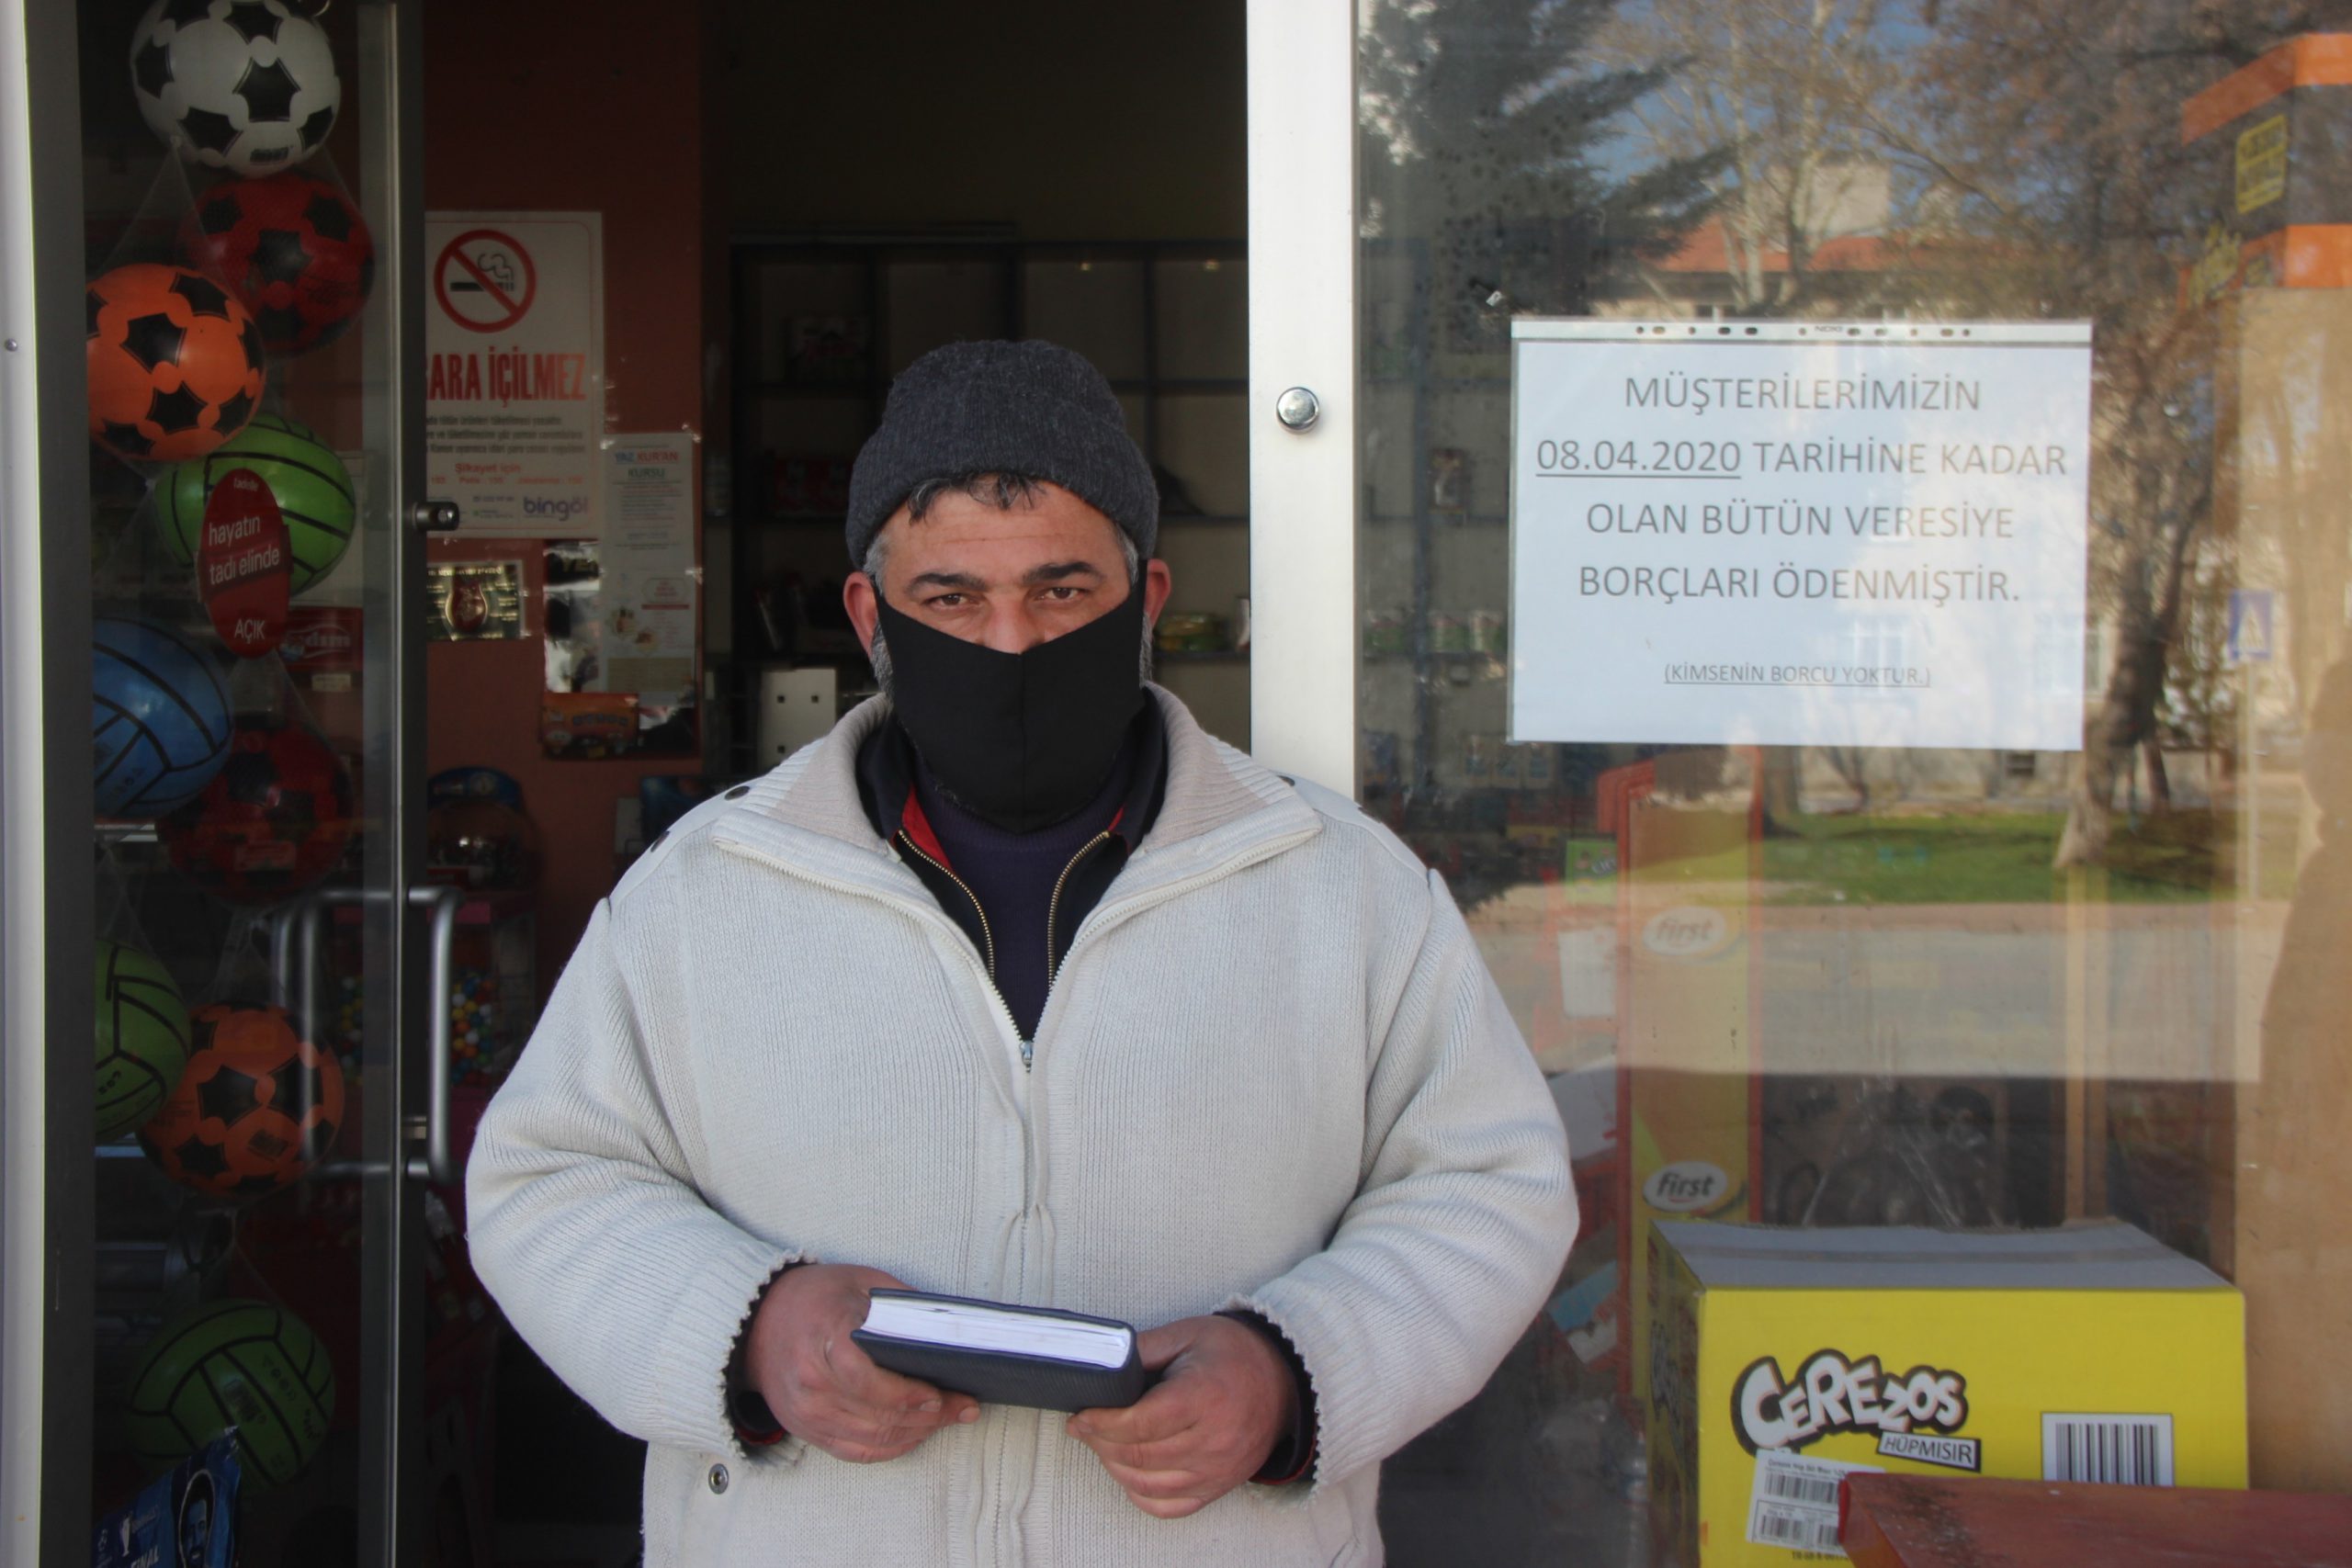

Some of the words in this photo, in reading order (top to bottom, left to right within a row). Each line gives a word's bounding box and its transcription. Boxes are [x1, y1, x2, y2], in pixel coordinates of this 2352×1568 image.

[425, 353, 482, 400] ARA
[488, 345, 587, 409] İÇİLMEZ
[1625, 370, 1980, 414] MÜŞTERİLERİMİZİN
[1536, 439, 1742, 479] 08.04.2020
[1752, 435, 1928, 474] TARİHİNE
[1940, 443, 2067, 476] KADAR
[208, 515, 262, 547] hayatın
[1587, 503, 1688, 535] OLAN
[1702, 498, 1831, 536] BÜTÜN
[1845, 502, 2014, 538] VERESİYE
[209, 556, 237, 586] tadı
[238, 543, 281, 577] elinde
[1580, 566, 1758, 604] BORÇLARI
[1772, 561, 2020, 608] ÖDENMİŞTİR.
[233, 617, 266, 645] AÇIK
[1664, 662, 1765, 684] (KİMSENİN
[1770, 665, 1837, 685] BORCU
[1841, 667, 1931, 689] YOKTUR.)
[1656, 918, 1713, 942] first
[1657, 1172, 1714, 1197] first
[1736, 1350, 1965, 1452] CEREZOS
[1883, 1435, 1973, 1464] HÜPMISIR
